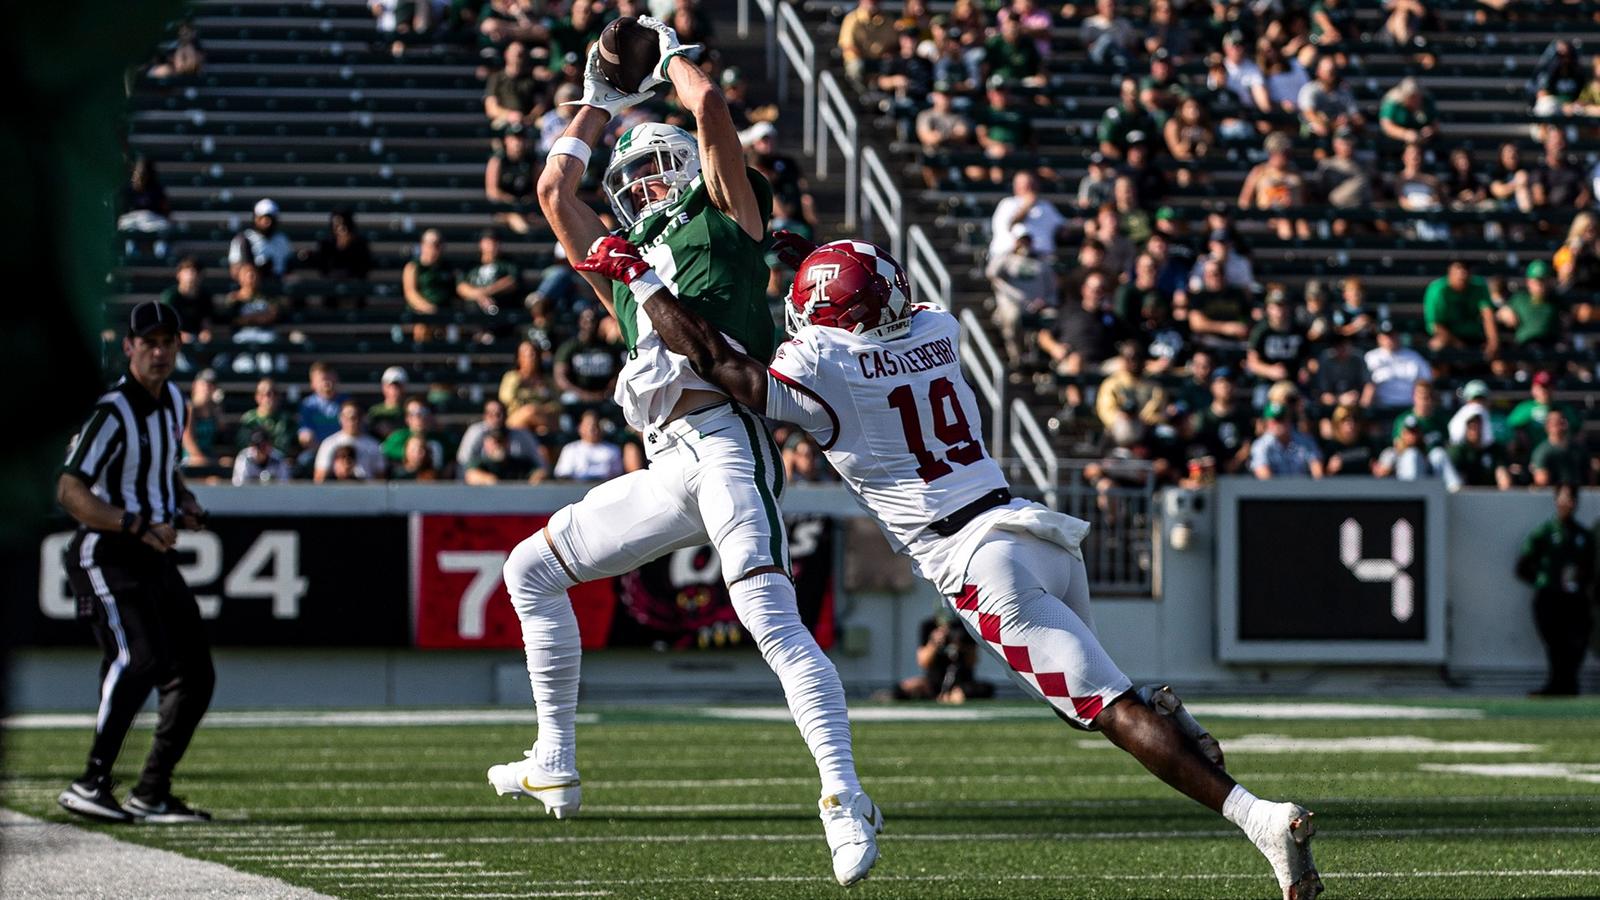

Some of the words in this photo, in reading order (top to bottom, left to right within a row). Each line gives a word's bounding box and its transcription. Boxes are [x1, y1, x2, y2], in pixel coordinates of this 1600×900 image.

[637, 211, 691, 256] LOTTE
[858, 336, 957, 379] CASTLEBERRY
[888, 377, 984, 483] 19
[436, 550, 508, 640] 7
[1339, 516, 1416, 623] 4
